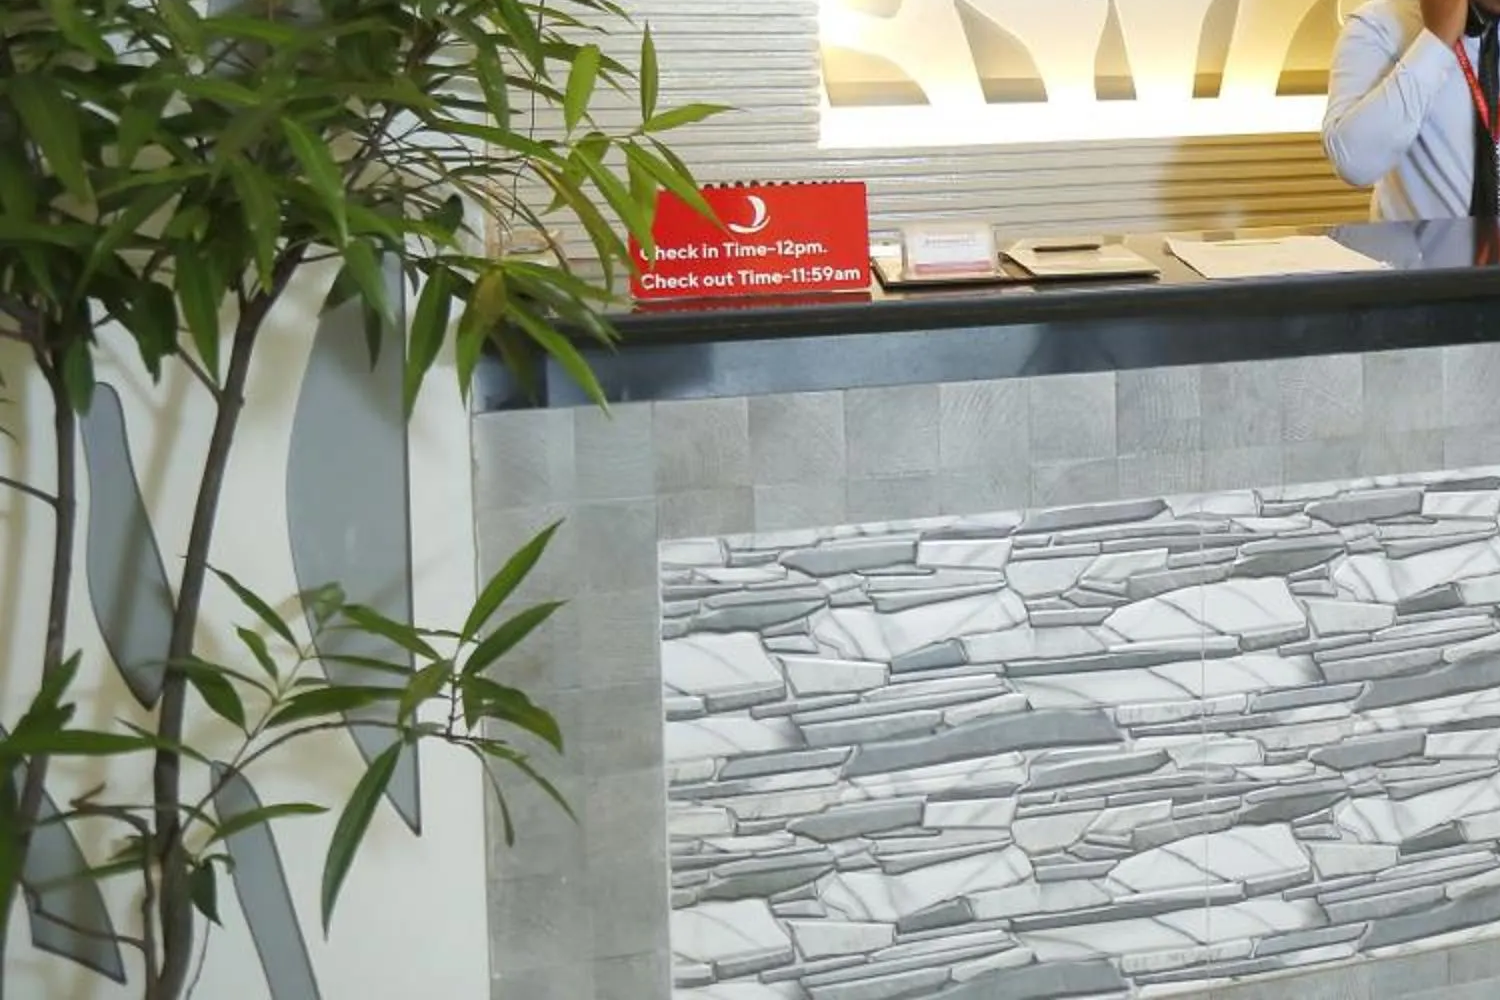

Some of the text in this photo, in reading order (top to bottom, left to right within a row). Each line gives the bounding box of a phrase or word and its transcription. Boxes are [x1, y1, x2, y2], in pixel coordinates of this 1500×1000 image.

[702, 243, 718, 258] in
[641, 267, 861, 290] Check out Time-11:59am
